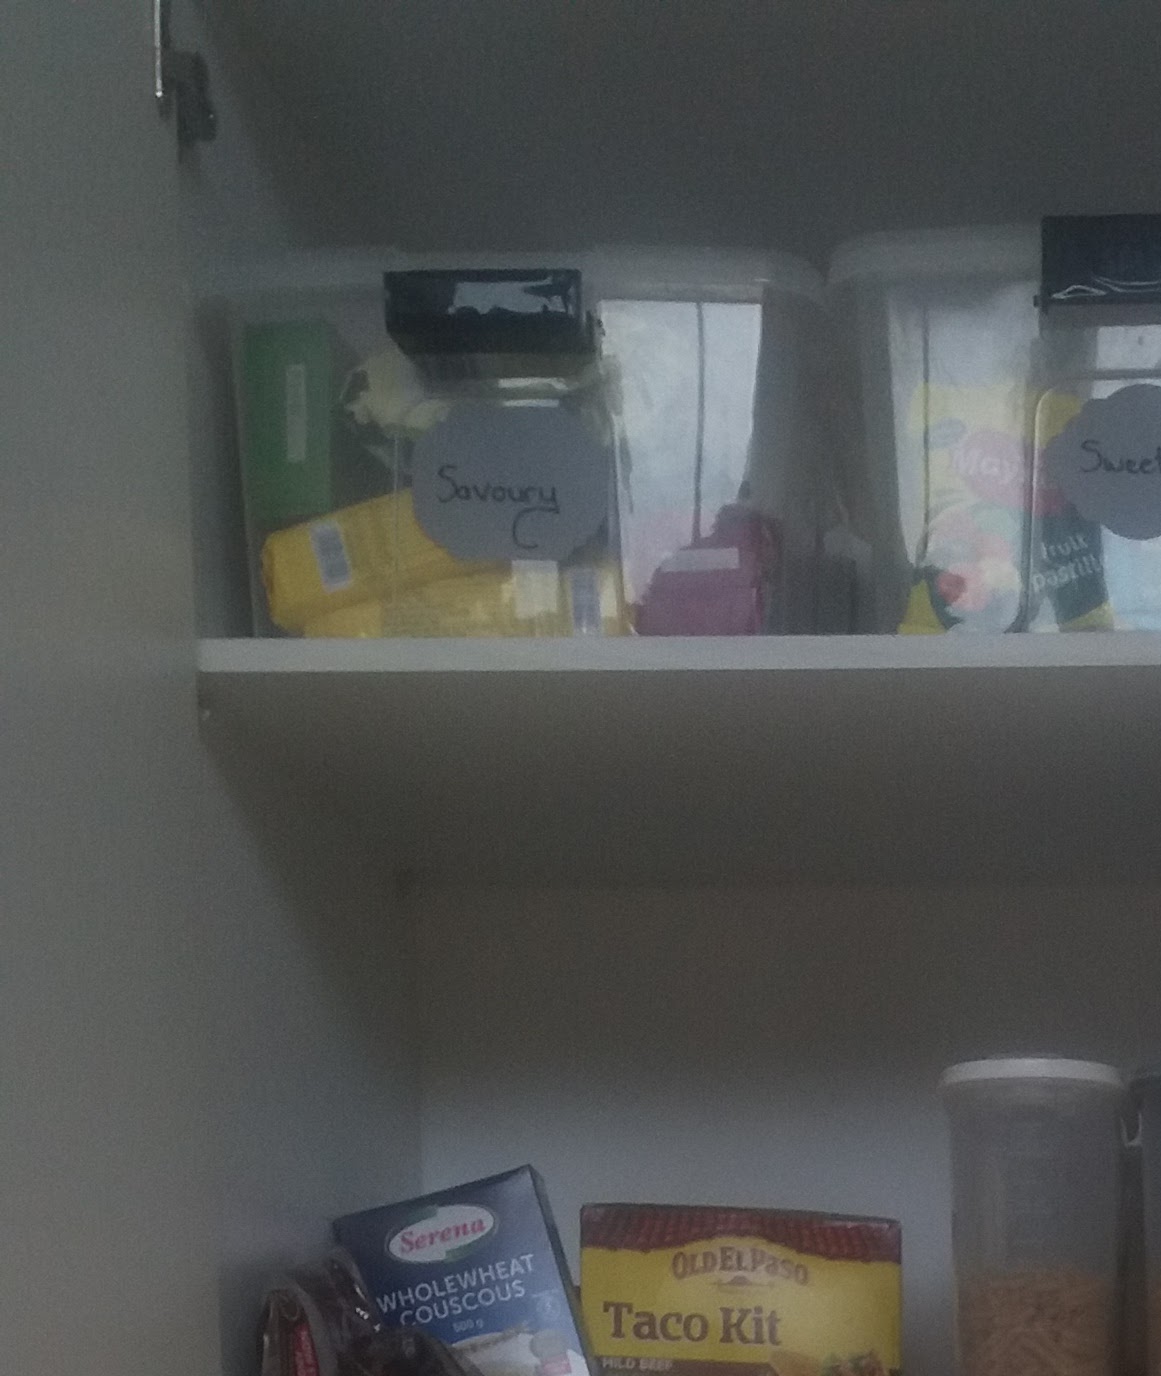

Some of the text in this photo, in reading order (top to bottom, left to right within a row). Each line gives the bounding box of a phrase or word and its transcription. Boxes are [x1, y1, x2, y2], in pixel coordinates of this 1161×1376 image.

[437, 463, 561, 549] Savoury
[399, 1217, 487, 1256] Serena
[375, 1252, 536, 1315] WHOLEWHEAT
[399, 1279, 527, 1328] COUSCOUS
[602, 1300, 782, 1347] Taco Kit
